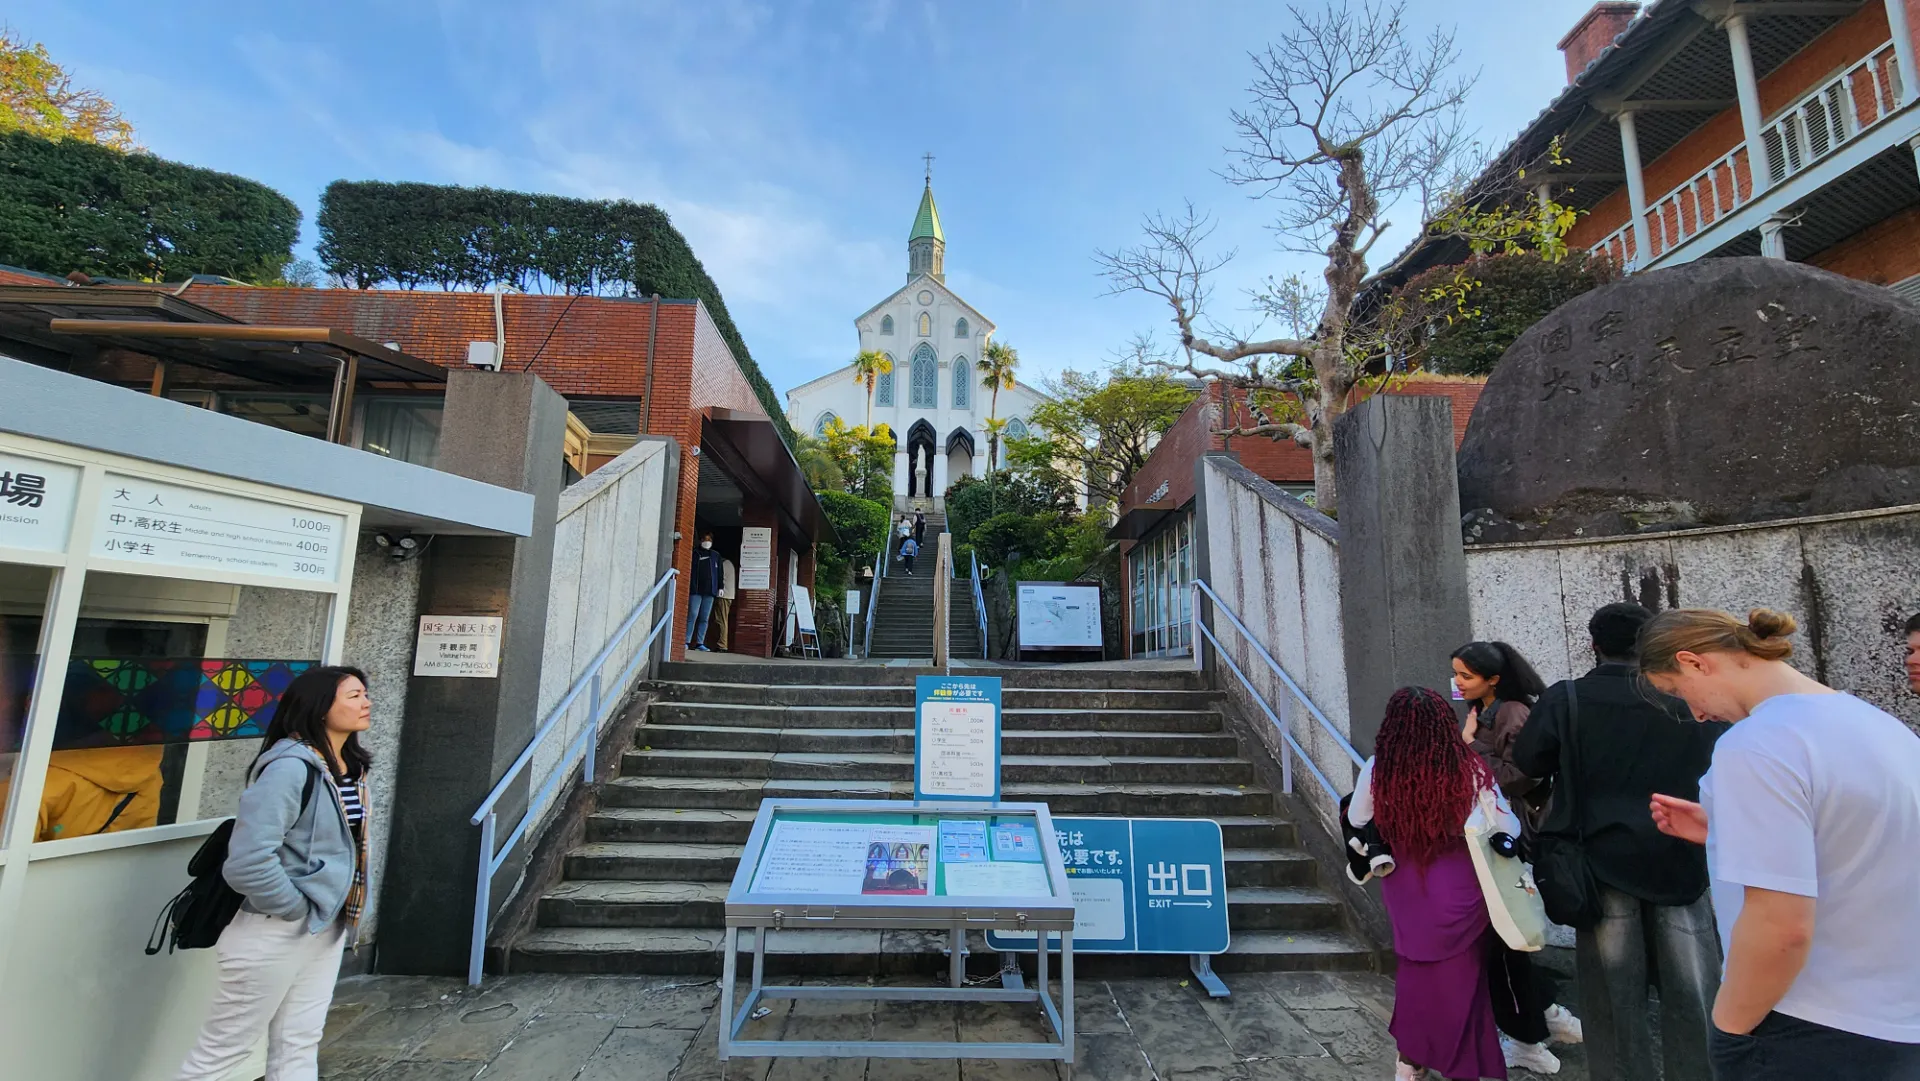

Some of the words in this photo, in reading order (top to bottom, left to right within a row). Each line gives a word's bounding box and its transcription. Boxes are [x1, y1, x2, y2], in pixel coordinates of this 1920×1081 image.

[188, 503, 212, 512] Adults
[0, 513, 39, 525] ission
[291, 517, 331, 533] 1,000円
[184, 527, 209, 536] Middle
[226, 533, 241, 541] high
[242, 535, 264, 544] school
[265, 538, 292, 548] students
[104, 539, 155, 556] 小学生
[296, 540, 328, 554] 400円
[180, 550, 222, 563] Elementary
[226, 557, 249, 565] school
[250, 560, 279, 568] students
[292, 561, 325, 575] 300円
[423, 622, 444, 632] 国宝
[446, 622, 497, 633] 大浦天主堂
[460, 652, 476, 660] Hours
[1147, 861, 1213, 896] 出口
[1148, 899, 1172, 908] EXIT
